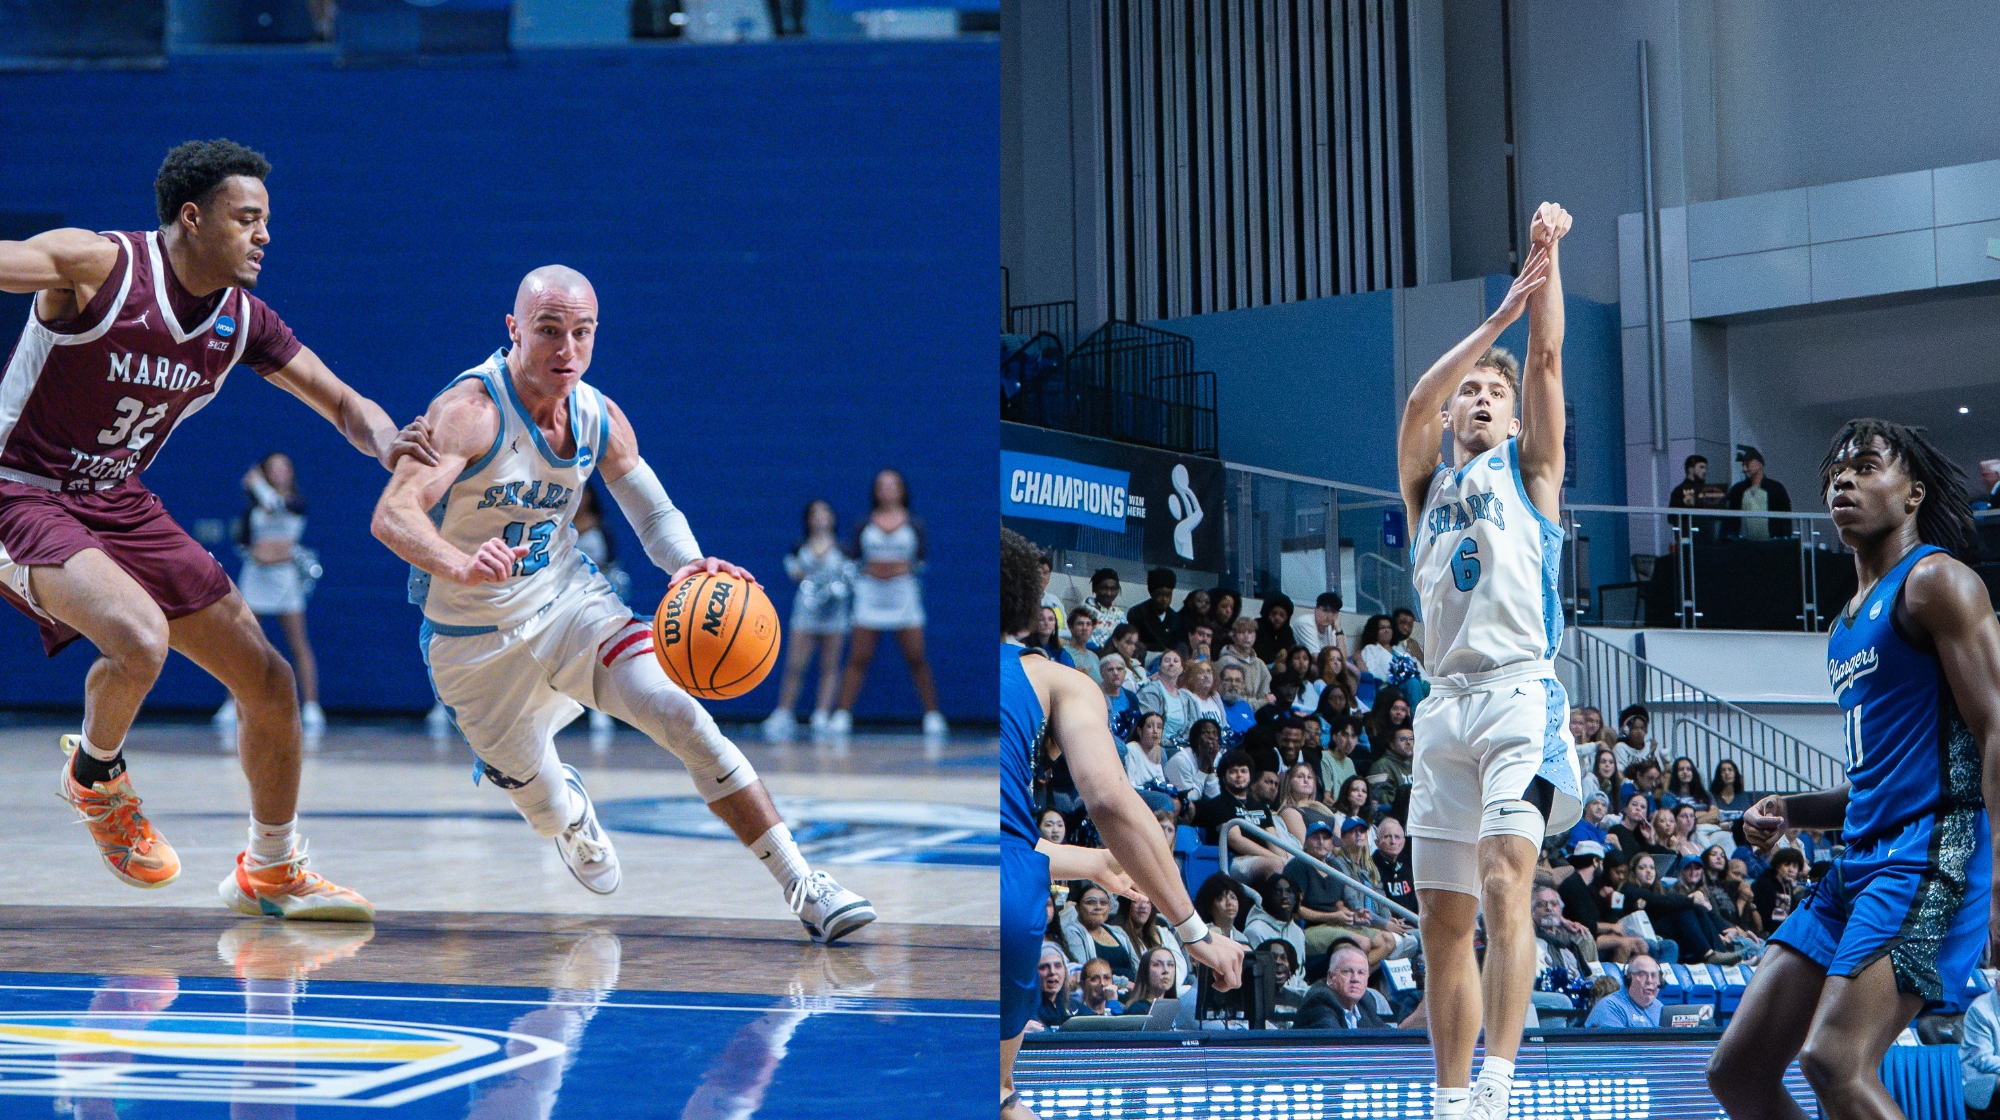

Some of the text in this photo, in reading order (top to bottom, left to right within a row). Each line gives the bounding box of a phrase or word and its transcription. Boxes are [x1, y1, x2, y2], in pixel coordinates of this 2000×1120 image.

[106, 352, 211, 391] MAROO
[97, 396, 169, 450] 32
[1010, 469, 1127, 519] CHAMPIONS
[1127, 505, 1147, 518] HERE
[1128, 494, 1145, 507] WIN
[1428, 491, 1505, 547] SHARKS
[502, 519, 557, 577] 12
[1451, 536, 1481, 592] 6
[664, 573, 704, 648] Wilson
[701, 581, 733, 638] NCAA
[1846, 703, 1864, 773] 11
